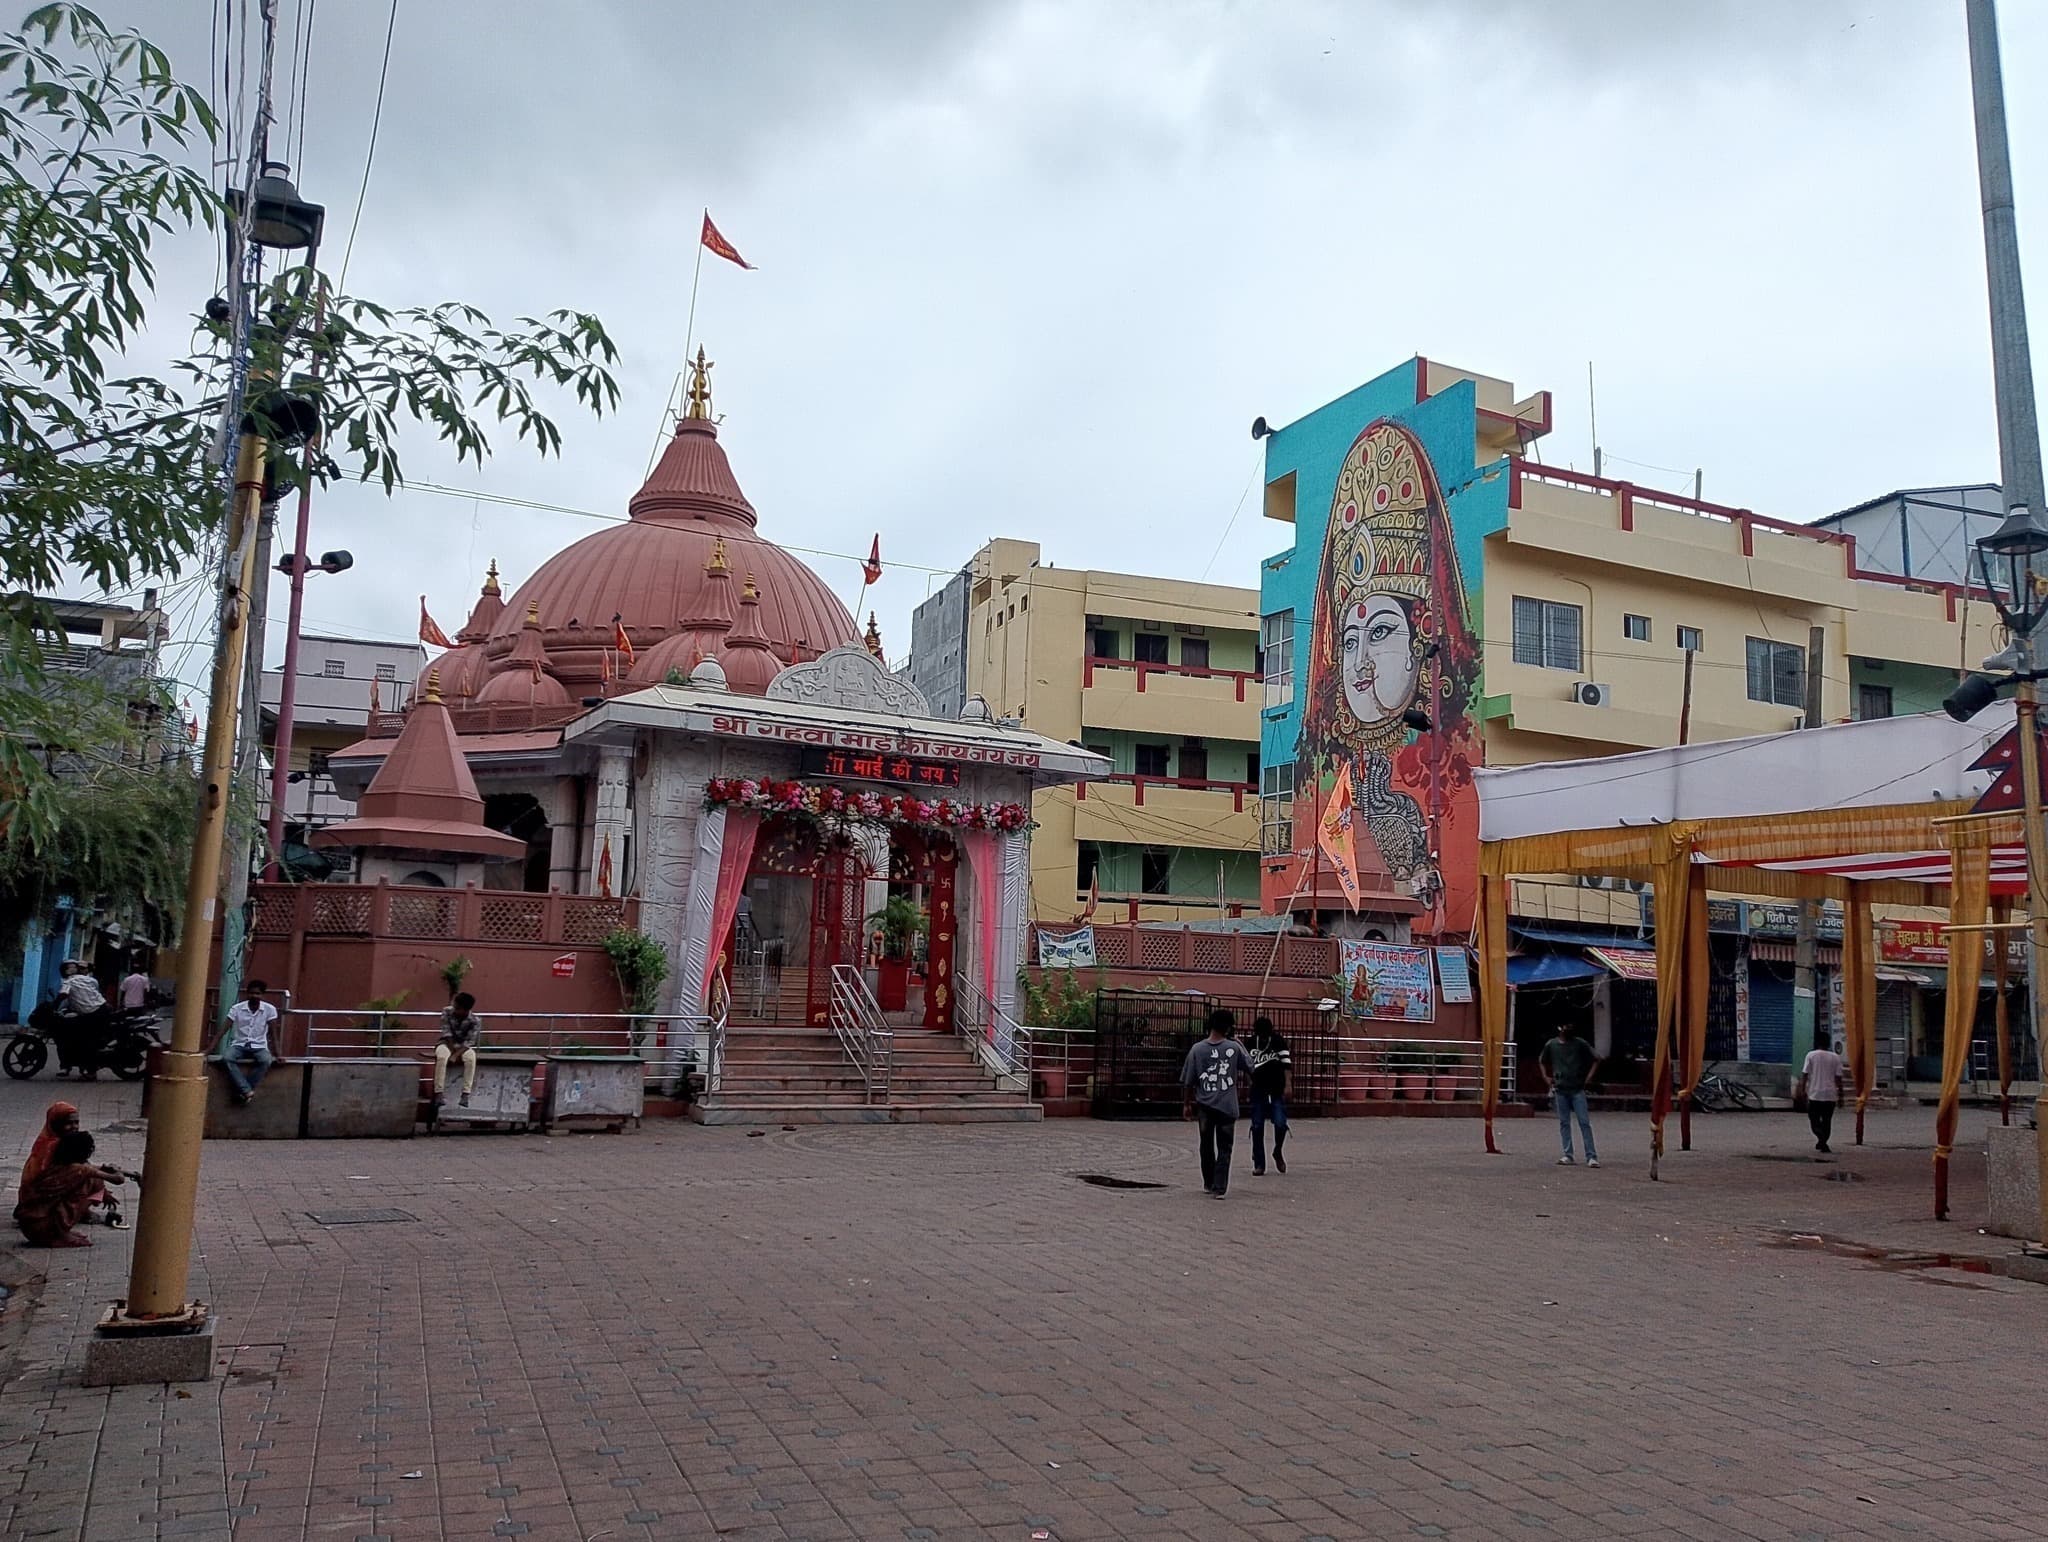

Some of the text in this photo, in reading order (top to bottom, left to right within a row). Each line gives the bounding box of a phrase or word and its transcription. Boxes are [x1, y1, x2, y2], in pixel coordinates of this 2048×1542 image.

[852, 755, 884, 779] माई
[890, 758, 913, 780] की
[920, 765, 945, 783] जय
[931, 742, 970, 760] जय
[970, 747, 1005, 765] जय
[1007, 750, 1041, 769] जय
